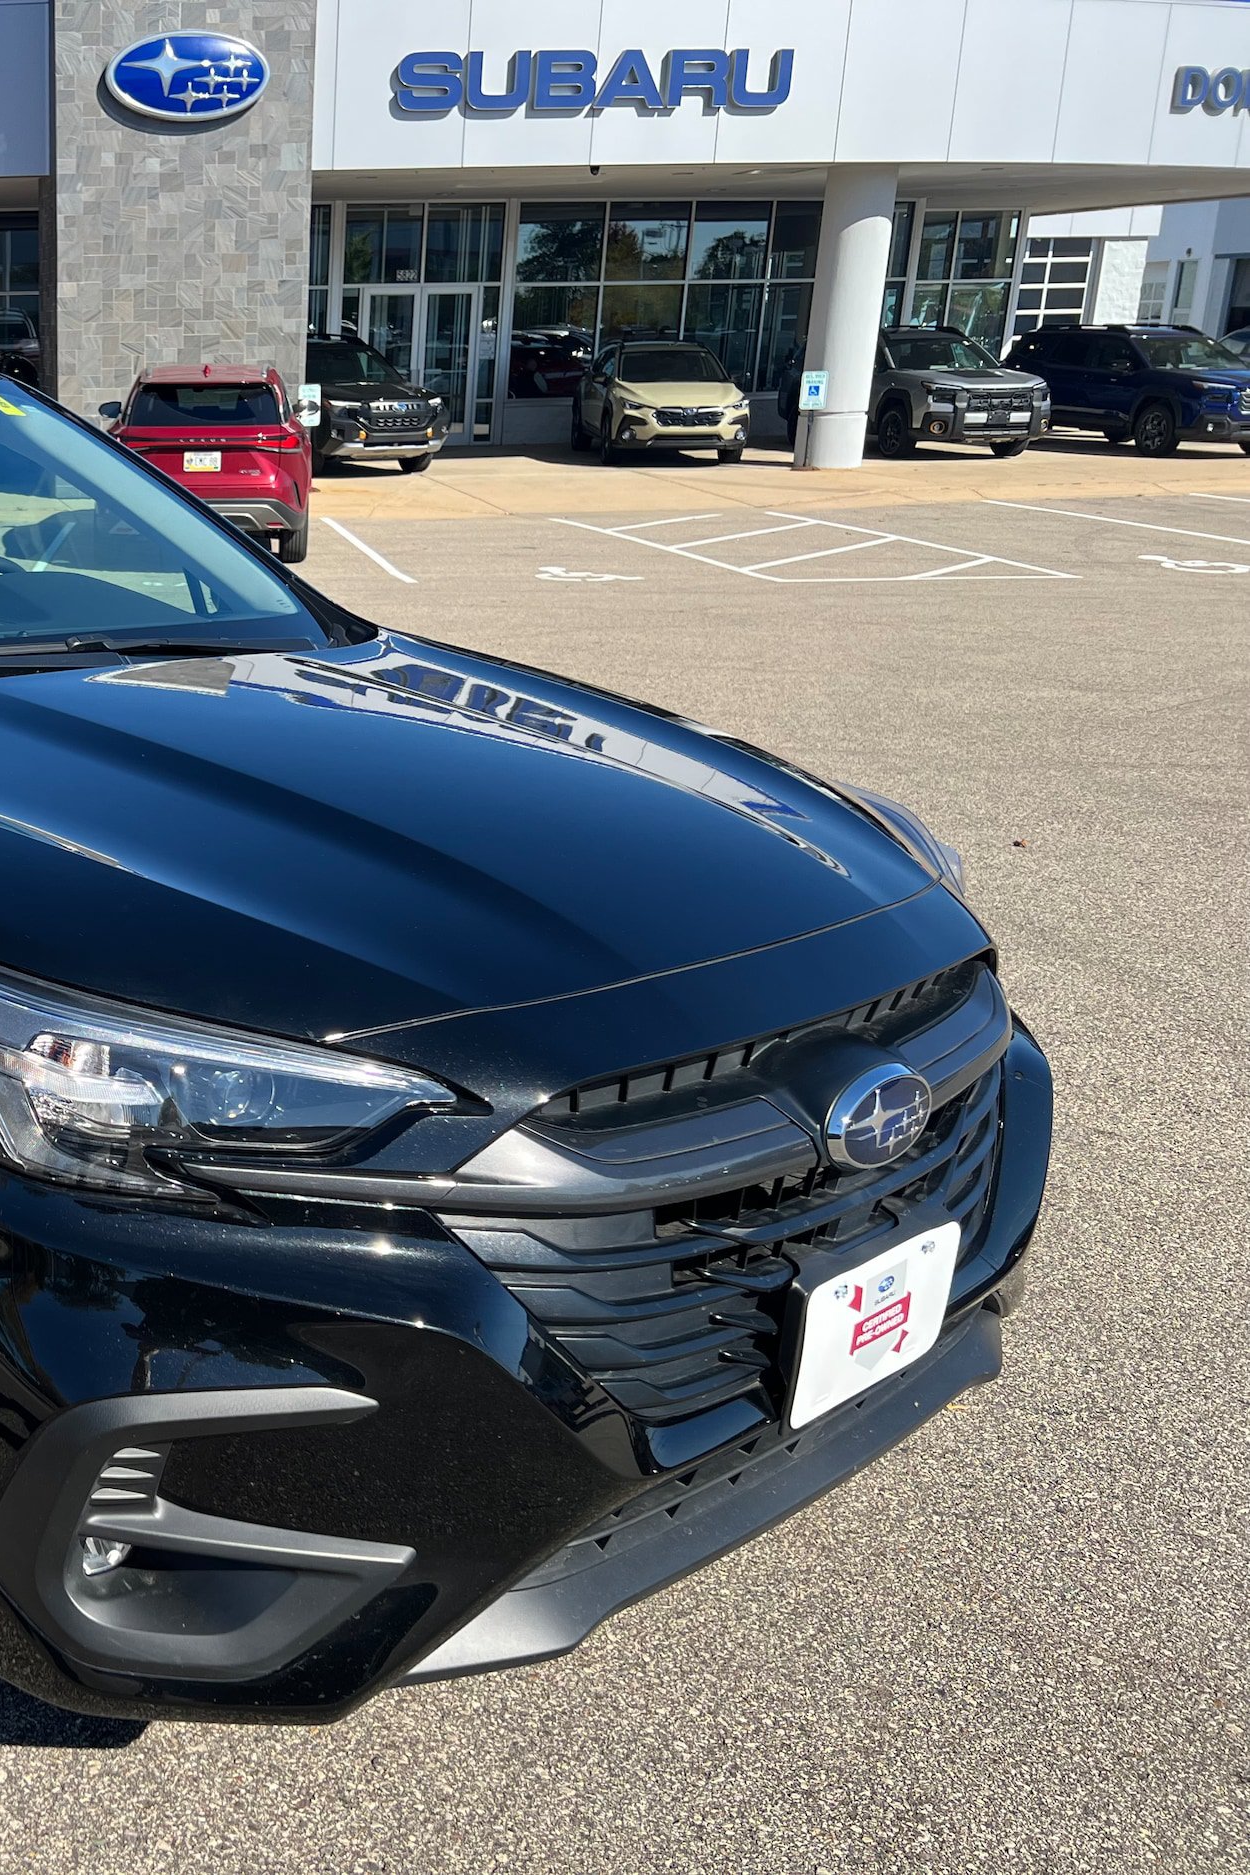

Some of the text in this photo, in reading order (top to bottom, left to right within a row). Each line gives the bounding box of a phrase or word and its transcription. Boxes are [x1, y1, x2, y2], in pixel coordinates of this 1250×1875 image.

[395, 48, 795, 111] SUBARU
[1177, 66, 1250, 109] DO
[855, 1312, 905, 1347] PRE-OWNED
[862, 1303, 903, 1333] CERTIFIED
